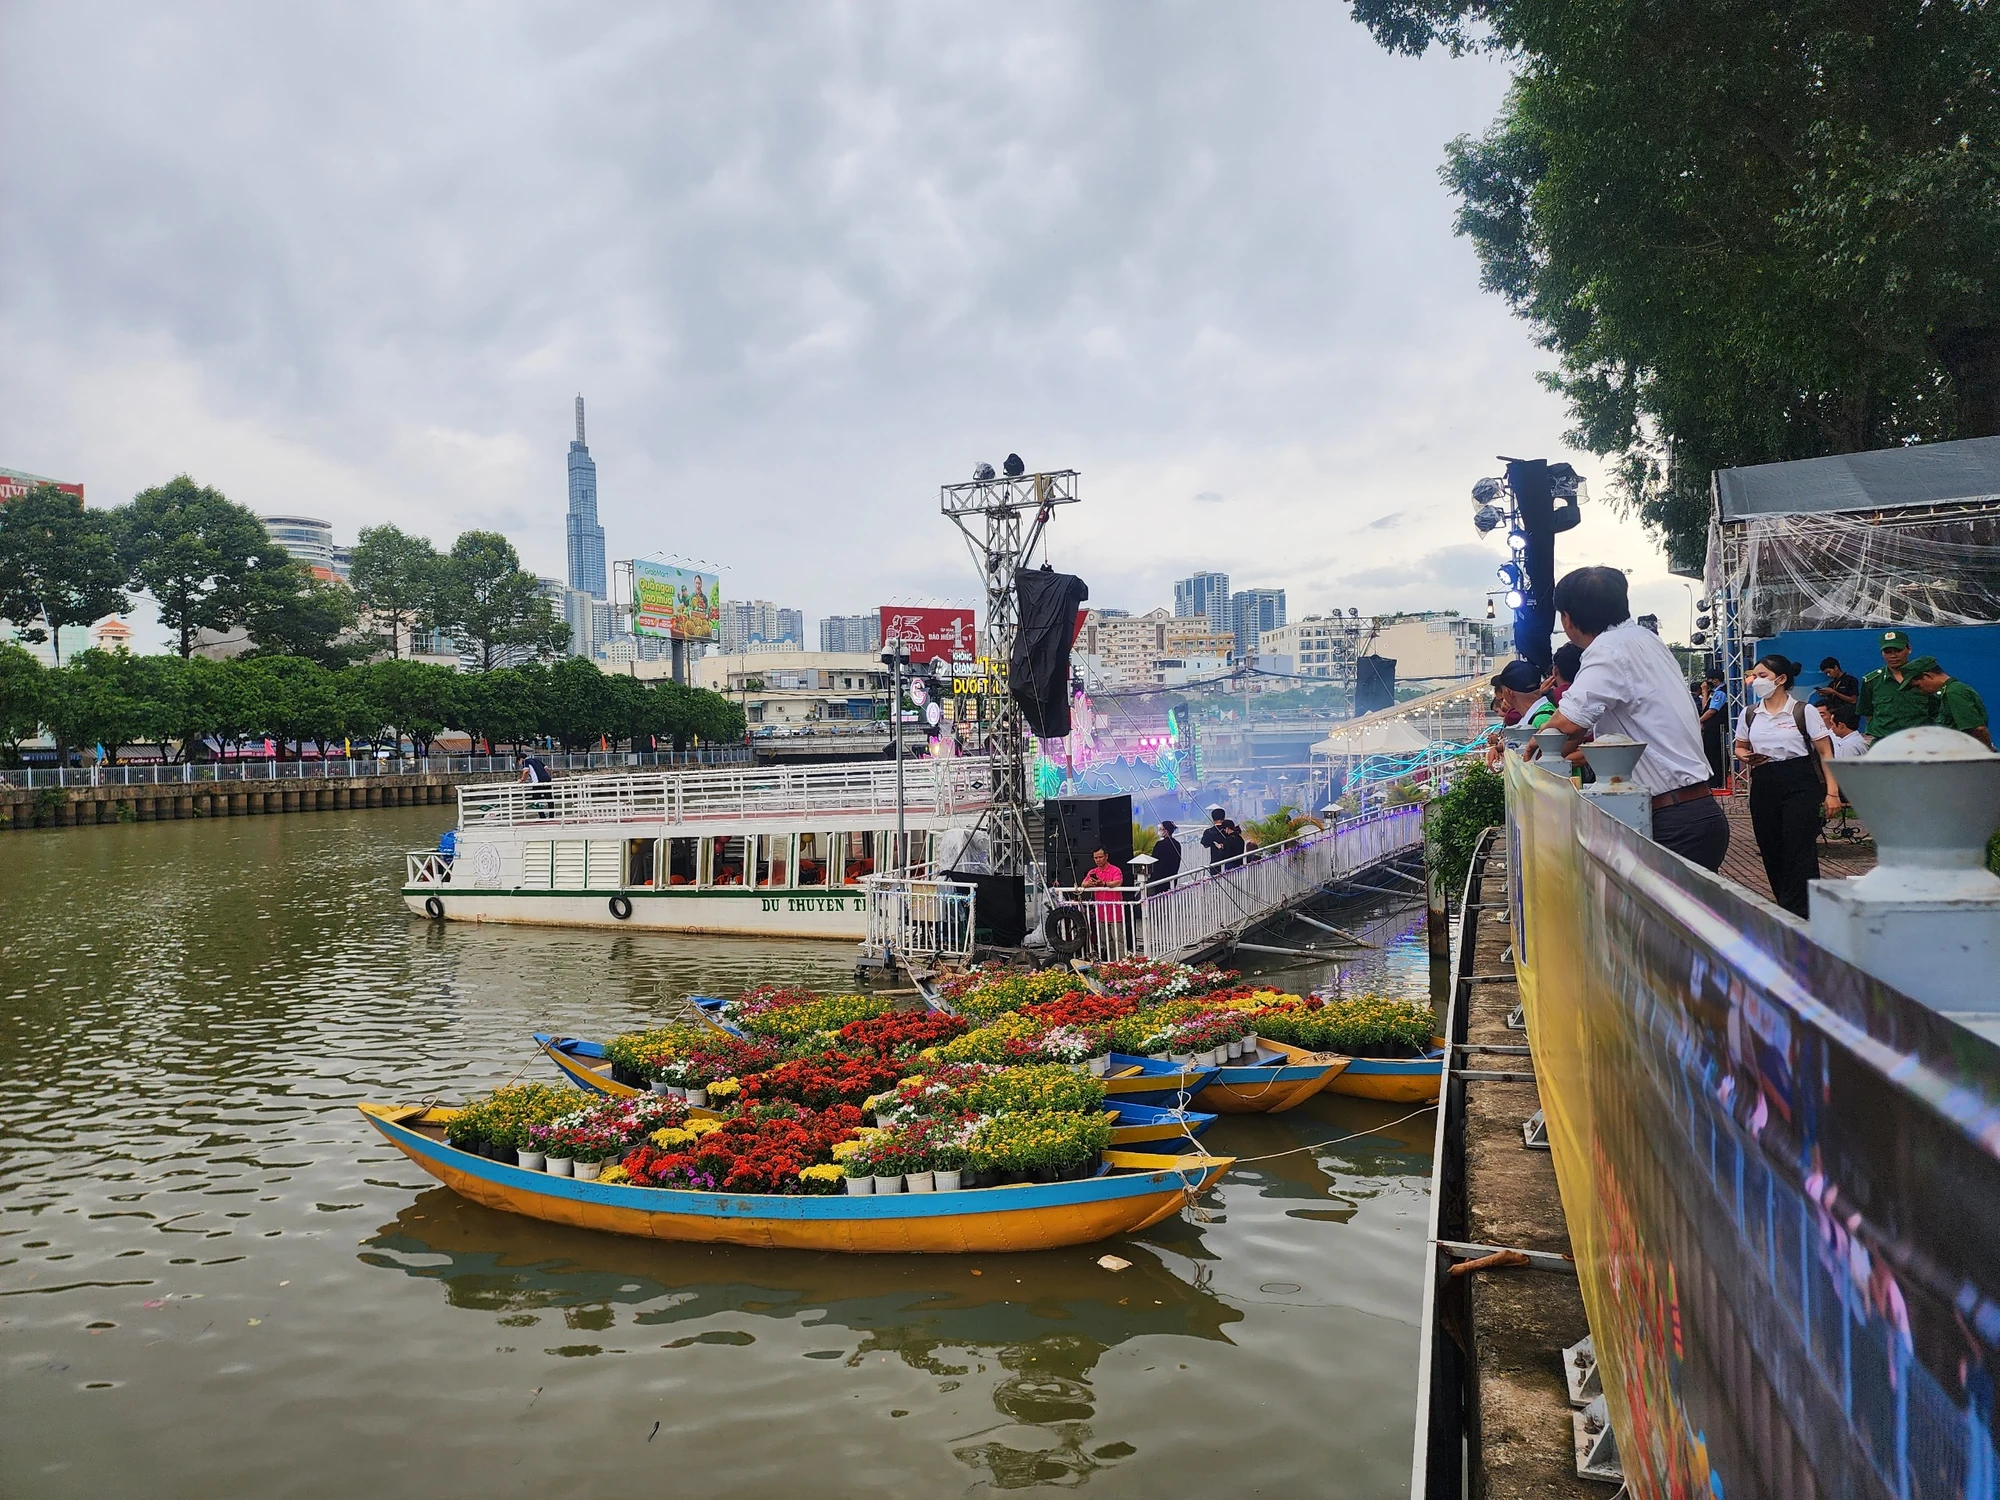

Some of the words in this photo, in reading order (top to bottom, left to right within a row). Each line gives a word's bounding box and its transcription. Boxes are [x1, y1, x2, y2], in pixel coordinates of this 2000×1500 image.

[645, 568, 669, 578] GrabMart
[640, 578, 655, 591] Quả
[655, 583, 674, 595] ngon
[951, 617, 965, 648] 1
[952, 652, 972, 661] KHÔNG
[952, 662, 973, 674] GIAN
[761, 898, 780, 912] DU
[787, 898, 845, 912] THUYEN
